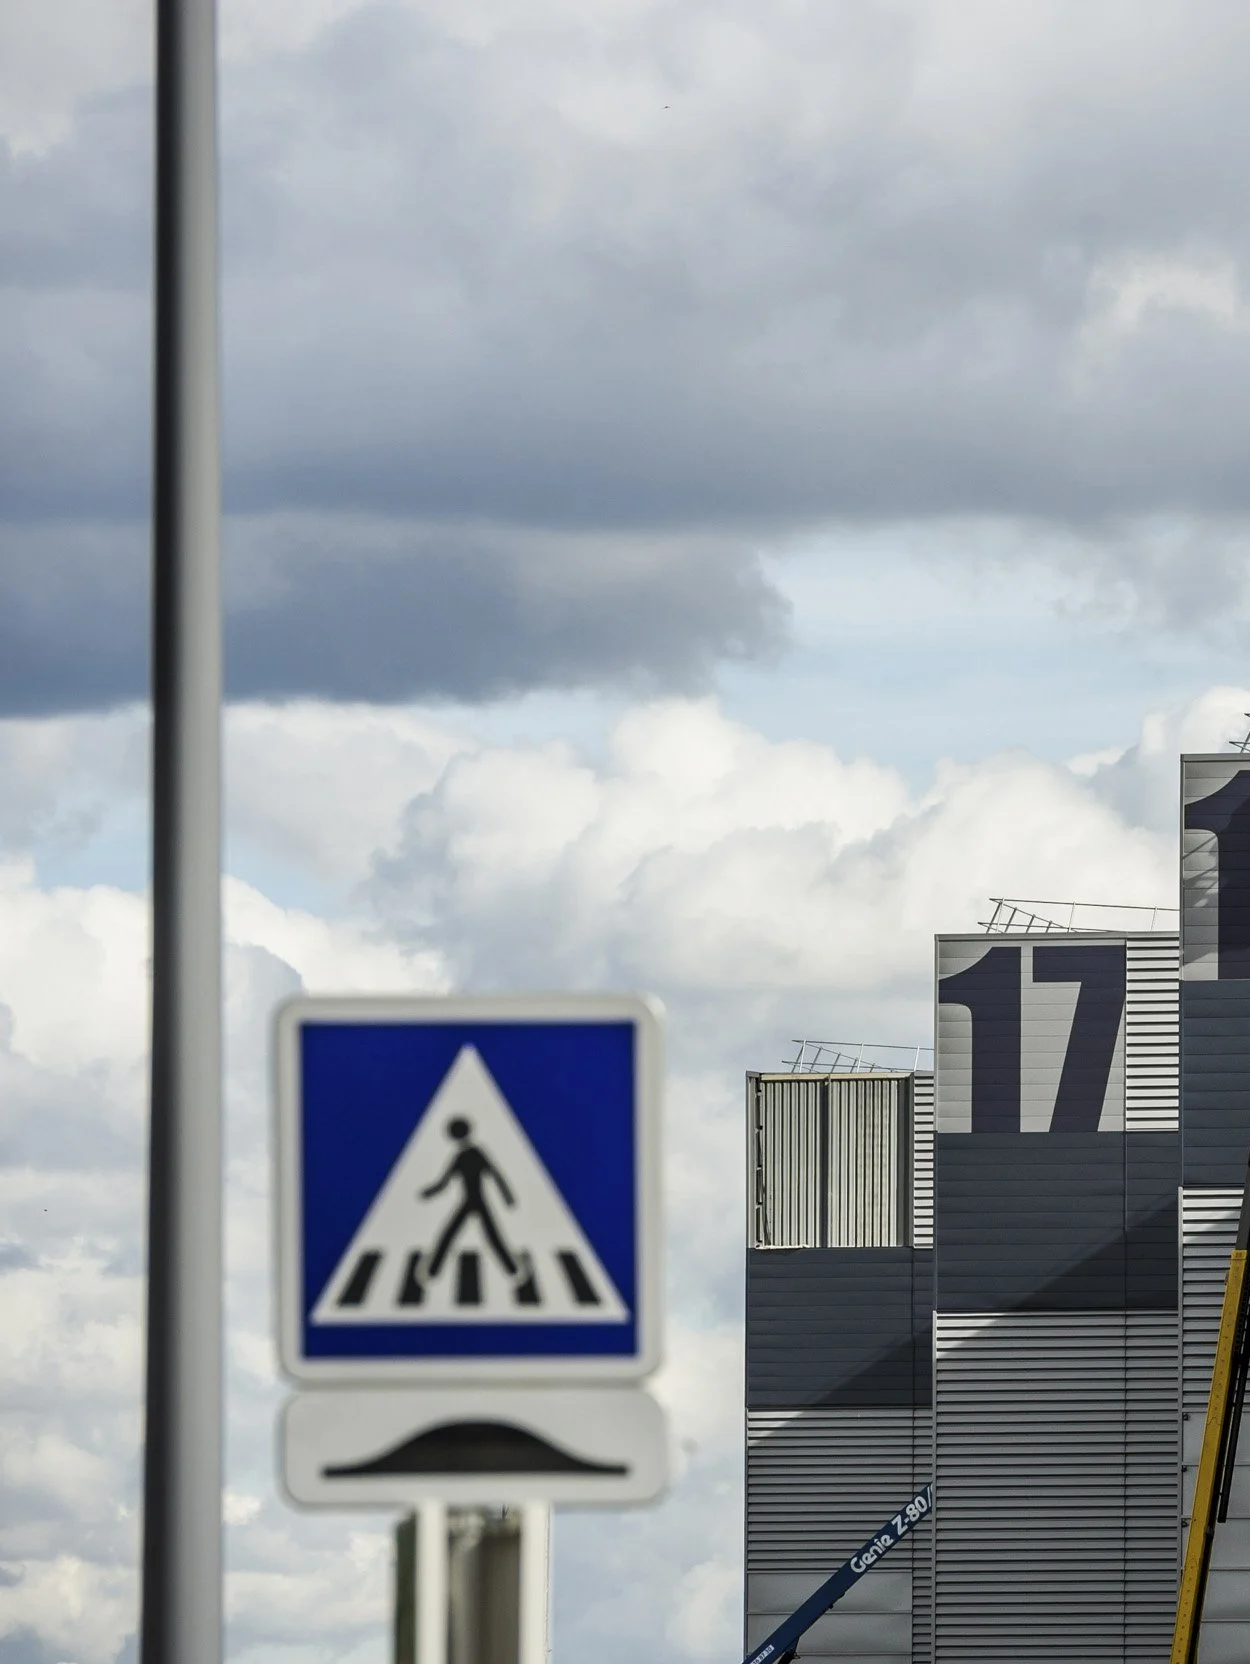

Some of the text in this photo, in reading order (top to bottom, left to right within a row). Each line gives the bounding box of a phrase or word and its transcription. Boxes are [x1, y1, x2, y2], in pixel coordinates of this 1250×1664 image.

[938, 945, 1126, 1133] 17
[850, 1484, 933, 1573] Genie Z-80/
